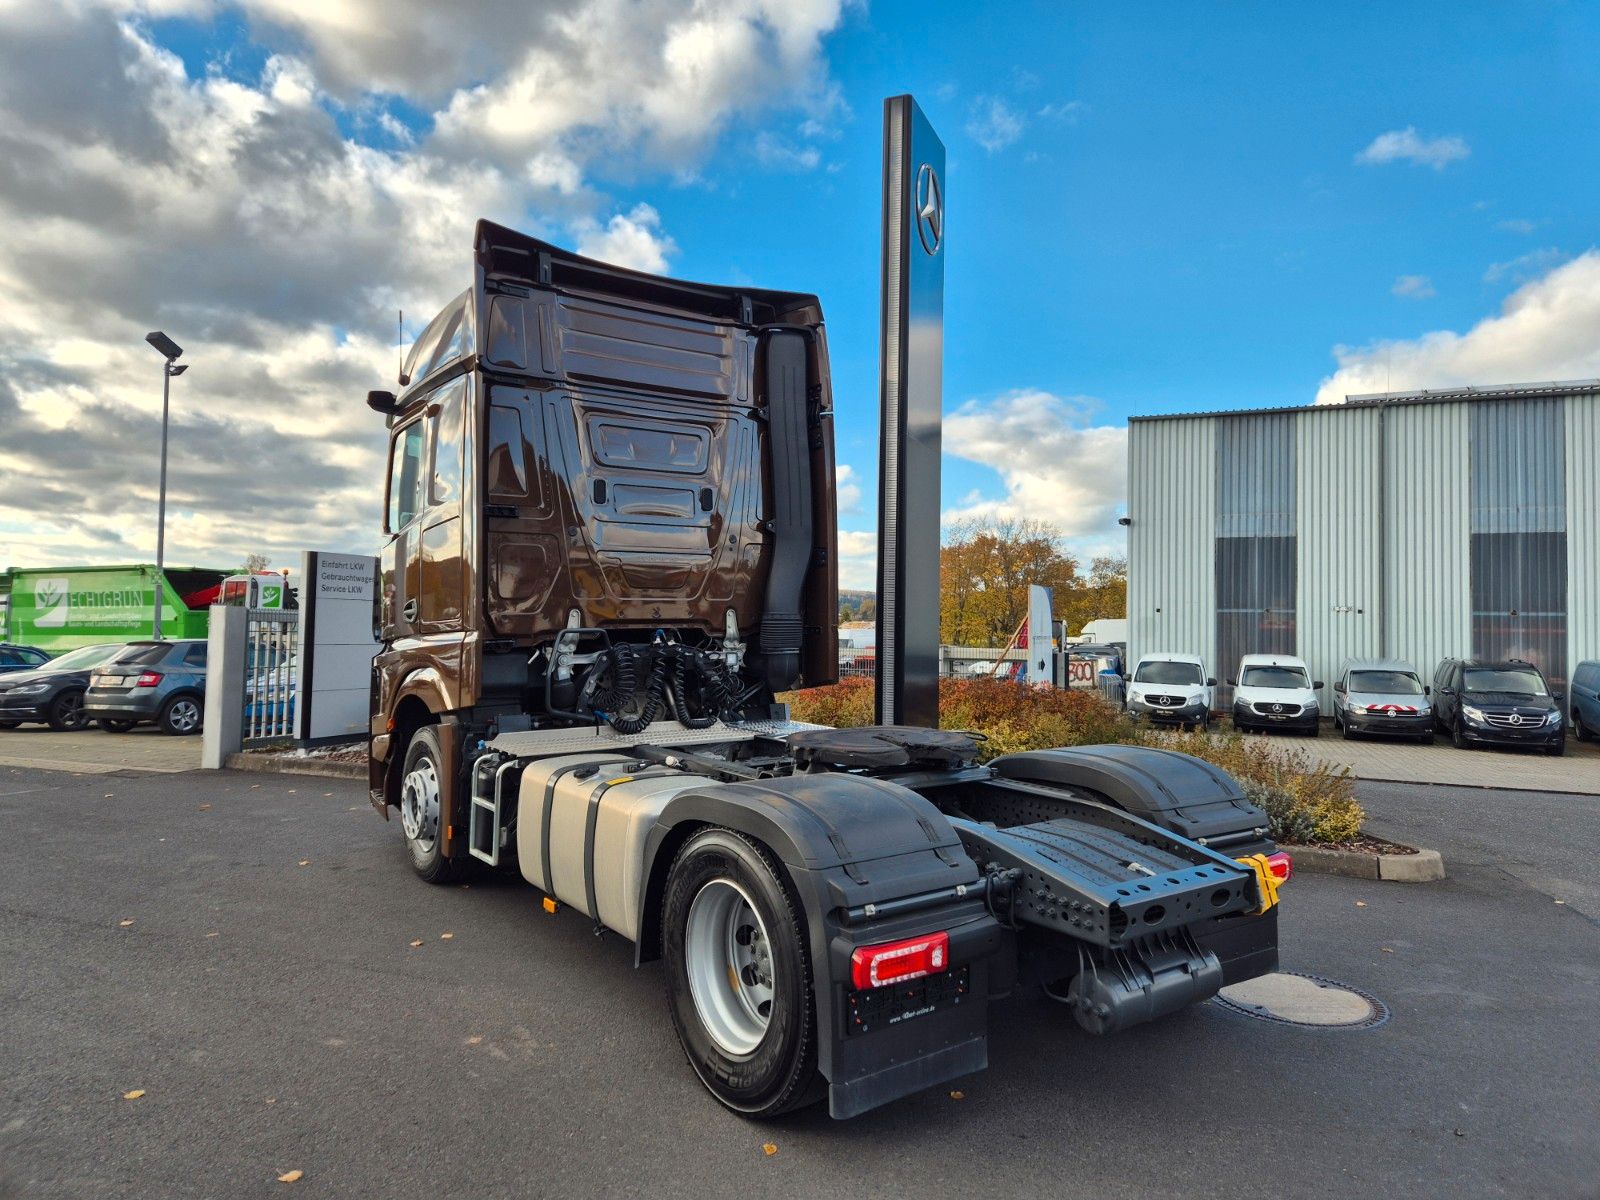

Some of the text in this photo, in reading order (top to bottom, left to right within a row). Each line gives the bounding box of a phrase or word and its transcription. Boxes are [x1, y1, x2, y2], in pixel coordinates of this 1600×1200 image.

[321, 560, 365, 571] Einfahrt LKW
[321, 584, 363, 594] Service LKW
